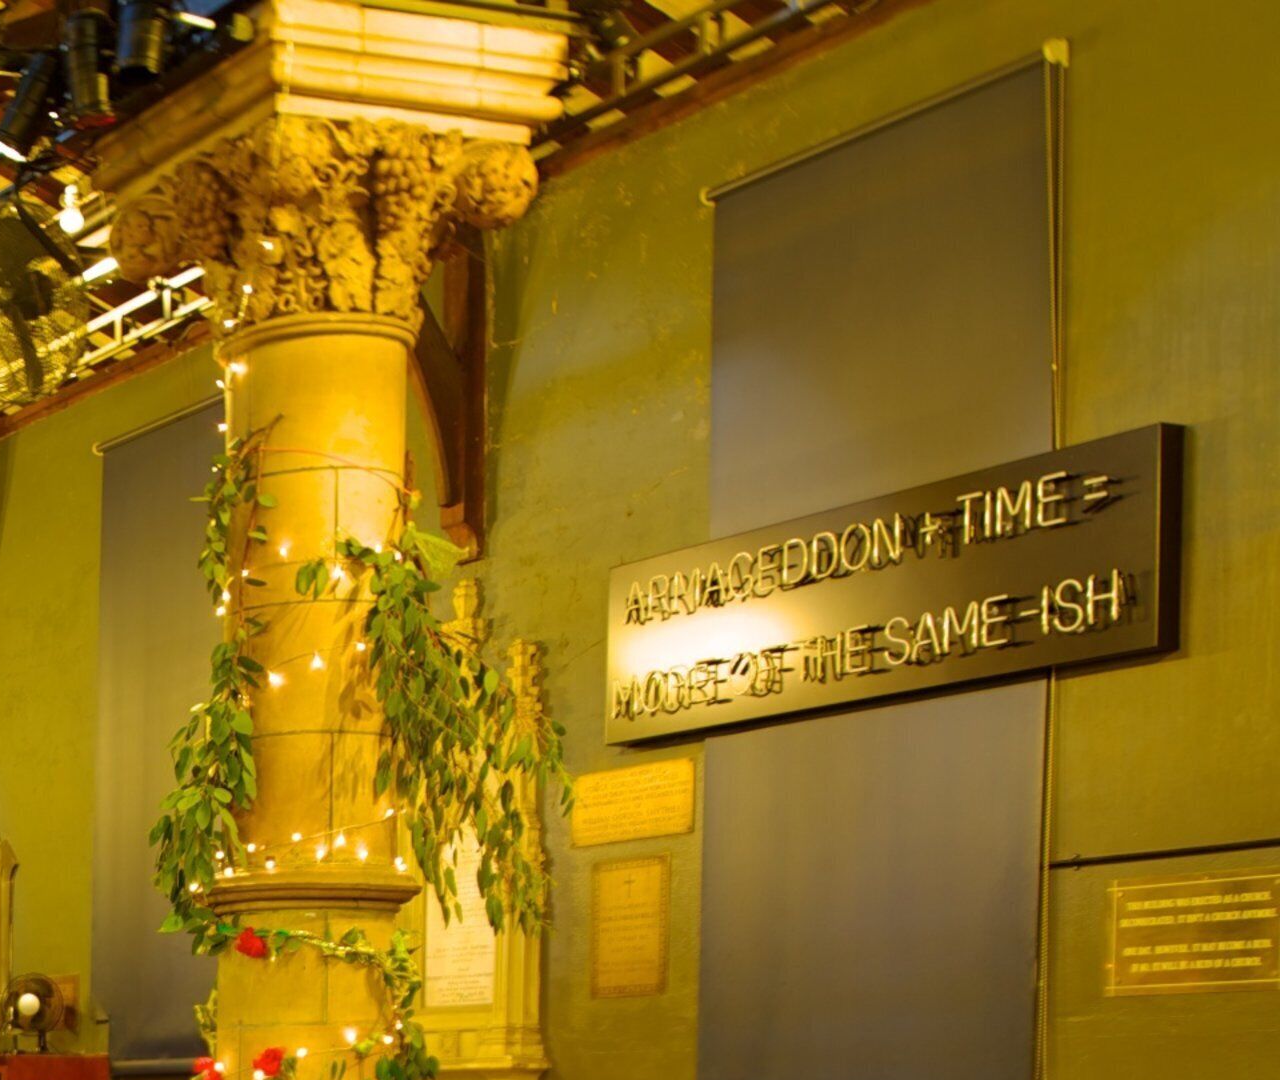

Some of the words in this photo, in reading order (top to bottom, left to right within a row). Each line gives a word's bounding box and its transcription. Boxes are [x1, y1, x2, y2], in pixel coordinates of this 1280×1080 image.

[624, 512, 903, 617] ARMAGEDDON
[956, 471, 1068, 545] TIME
[728, 643, 781, 696] OF
[793, 624, 870, 683] THE
